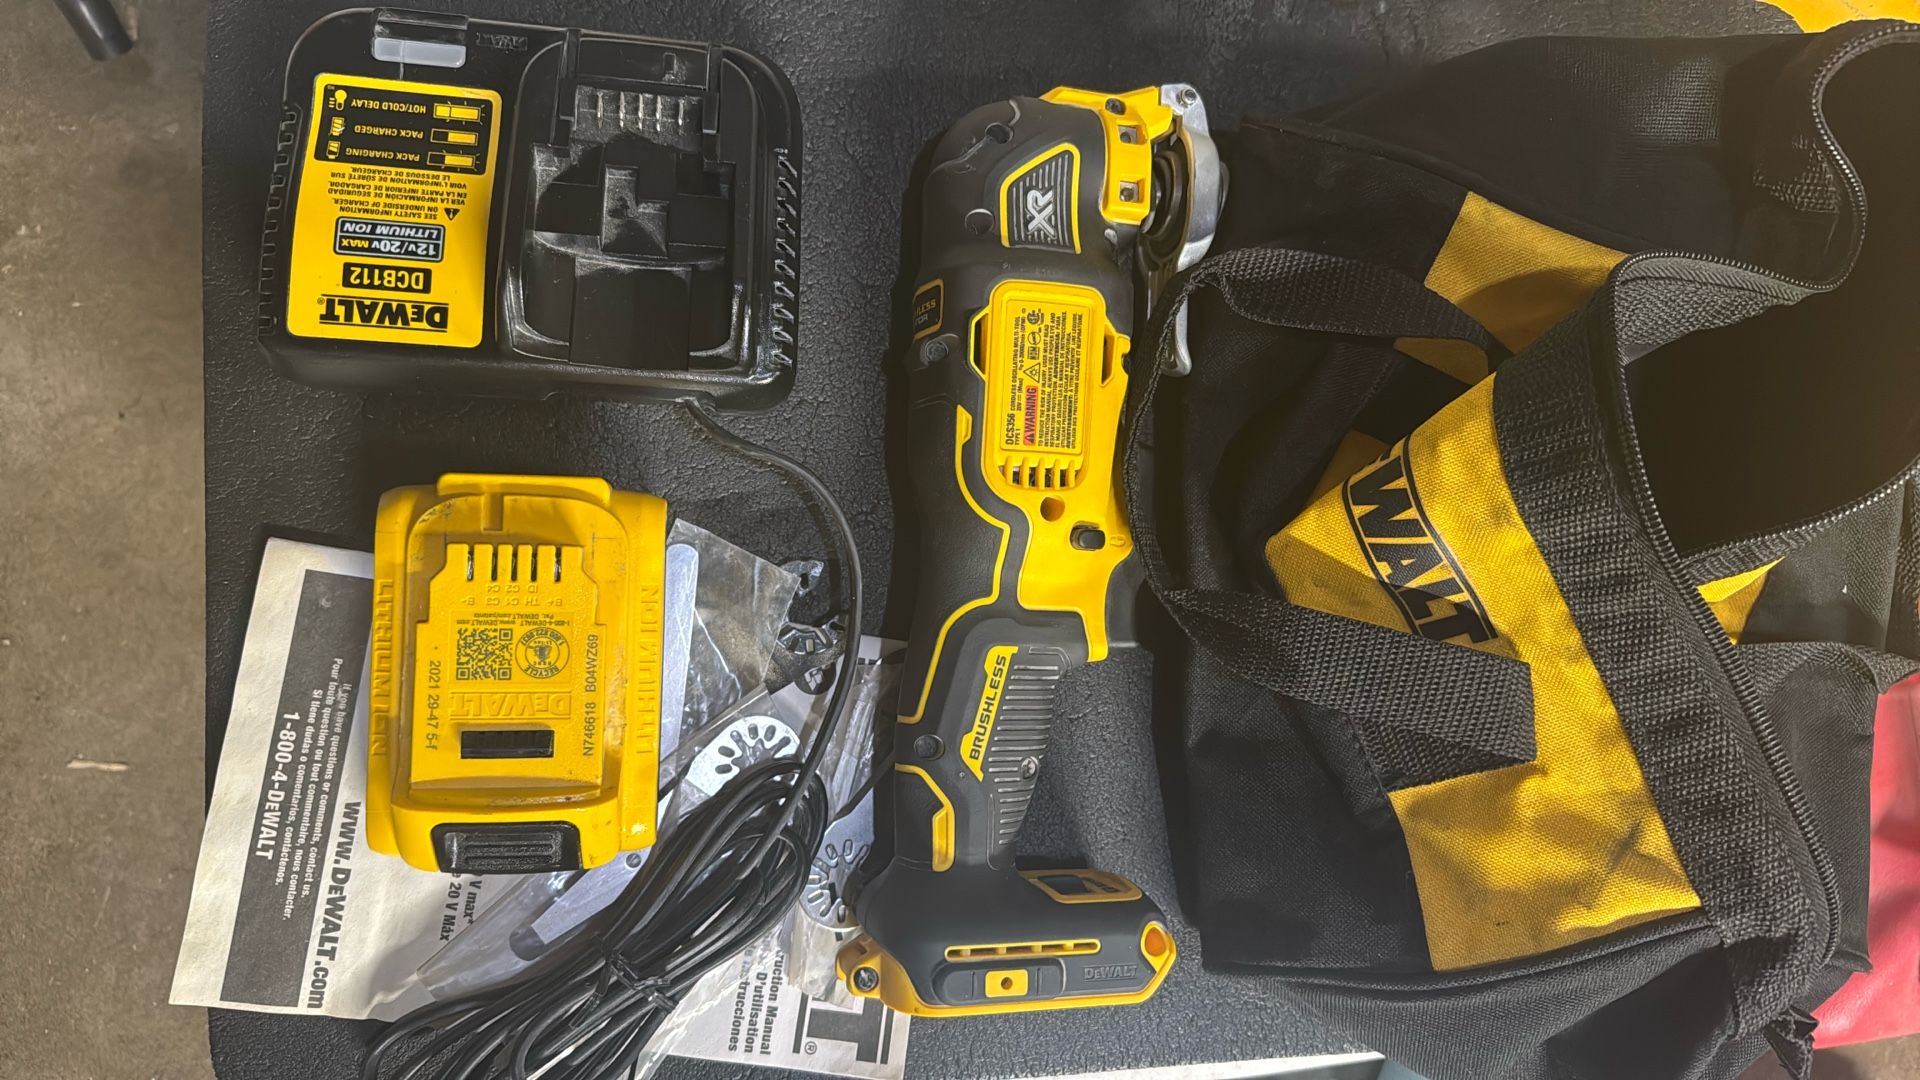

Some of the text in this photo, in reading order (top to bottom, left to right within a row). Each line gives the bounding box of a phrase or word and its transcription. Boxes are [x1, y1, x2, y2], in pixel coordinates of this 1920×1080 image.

[350, 97, 426, 113] HOT/COLD DELAY
[353, 124, 423, 138] PACK CHARGED
[345, 147, 419, 160] PACK CHARGING
[350, 166, 392, 175] CHARGEUR.
[409, 171, 440, 180] DESSOUS
[327, 180, 371, 190] CARGADOR.
[327, 187, 371, 197] SEGURIDAD
[372, 191, 383, 199] DE
[384, 185, 418, 194] INFERIOR
[420, 188, 444, 196] PARTE
[332, 197, 369, 207] CHARGER.
[370, 200, 380, 208] OF
[382, 202, 425, 212] UNDERSIDE
[385, 192, 438, 203] INFORMACIÓN
[450, 198, 465, 206] VER
[339, 205, 392, 216] INFORMATION
[394, 210, 421, 219] SAFETY
[1025, 189, 1055, 238] XR
[343, 221, 437, 238] LITHIUM ION
[340, 237, 369, 250] MAX
[348, 265, 424, 289] DCB112
[319, 297, 448, 329] DEWALT
[1025, 387, 1036, 432] WARNING
[1004, 413, 1015, 444] DCS356
[1348, 447, 1494, 644] WALT
[370, 578, 393, 756] LITHIUM ION
[428, 660, 441, 688] 2021
[522, 664, 559, 677] RECYCLE
[636, 583, 658, 753] LITHIUM ION
[310, 688, 322, 698] Si
[340, 682, 352, 691] If
[582, 633, 598, 756] N746618 B04WZ69
[305, 700, 320, 724] tiene
[426, 694, 439, 728] 29-47
[968, 654, 1007, 760] BRUSHLESS
[331, 710, 346, 733] have
[299, 724, 315, 754] dudas
[322, 733, 342, 781] questions
[255, 709, 299, 860] 1-800-4-DEWALT
[280, 656, 343, 921] Pour toute question ou tout commentaire, nous contacter.
[285, 763, 307, 825] comentarios,
[319, 781, 332, 793] or
[309, 793, 330, 845] comments,
[272, 825, 295, 886] contáctenos.
[301, 845, 319, 883] contact
[298, 883, 312, 899] us.
[447, 881, 461, 899] 20
[468, 878, 482, 889] V
[306, 798, 362, 1011] www.DEWALT.com
[445, 901, 458, 911] V
[439, 913, 455, 942] Máx
[727, 960, 752, 1052] trucciones
[743, 971, 767, 1054] D'utilisation
[759, 1004, 777, 1056] Manual
